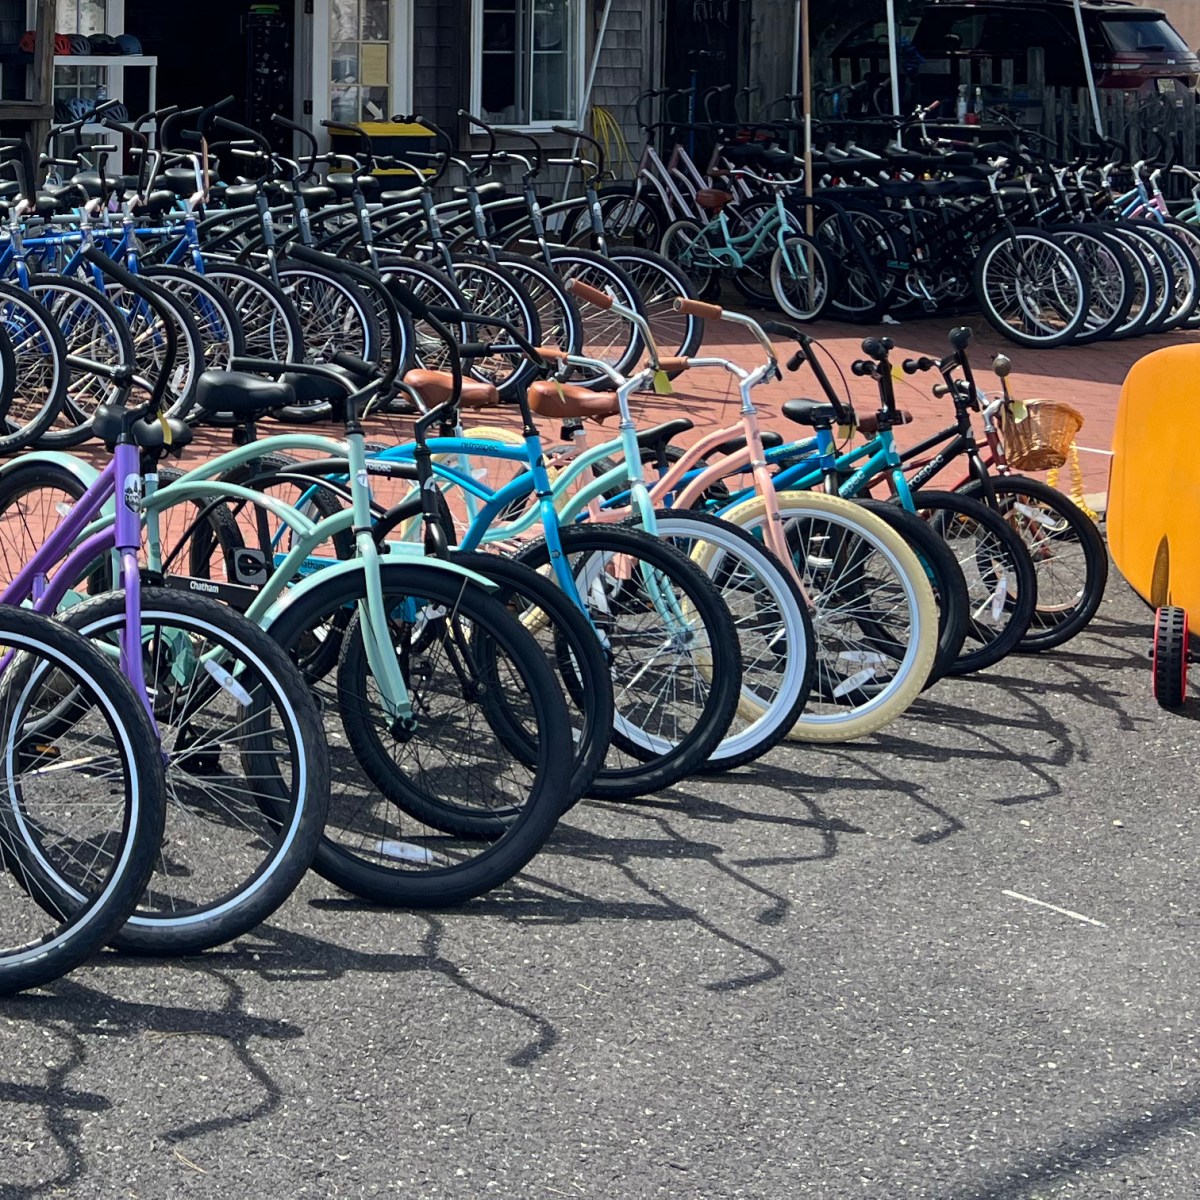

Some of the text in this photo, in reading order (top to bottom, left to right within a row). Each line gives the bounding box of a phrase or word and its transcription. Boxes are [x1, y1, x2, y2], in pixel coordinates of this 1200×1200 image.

[365, 462, 392, 473] rospec
[907, 454, 944, 489] rospec
[190, 580, 219, 593] Chatham
